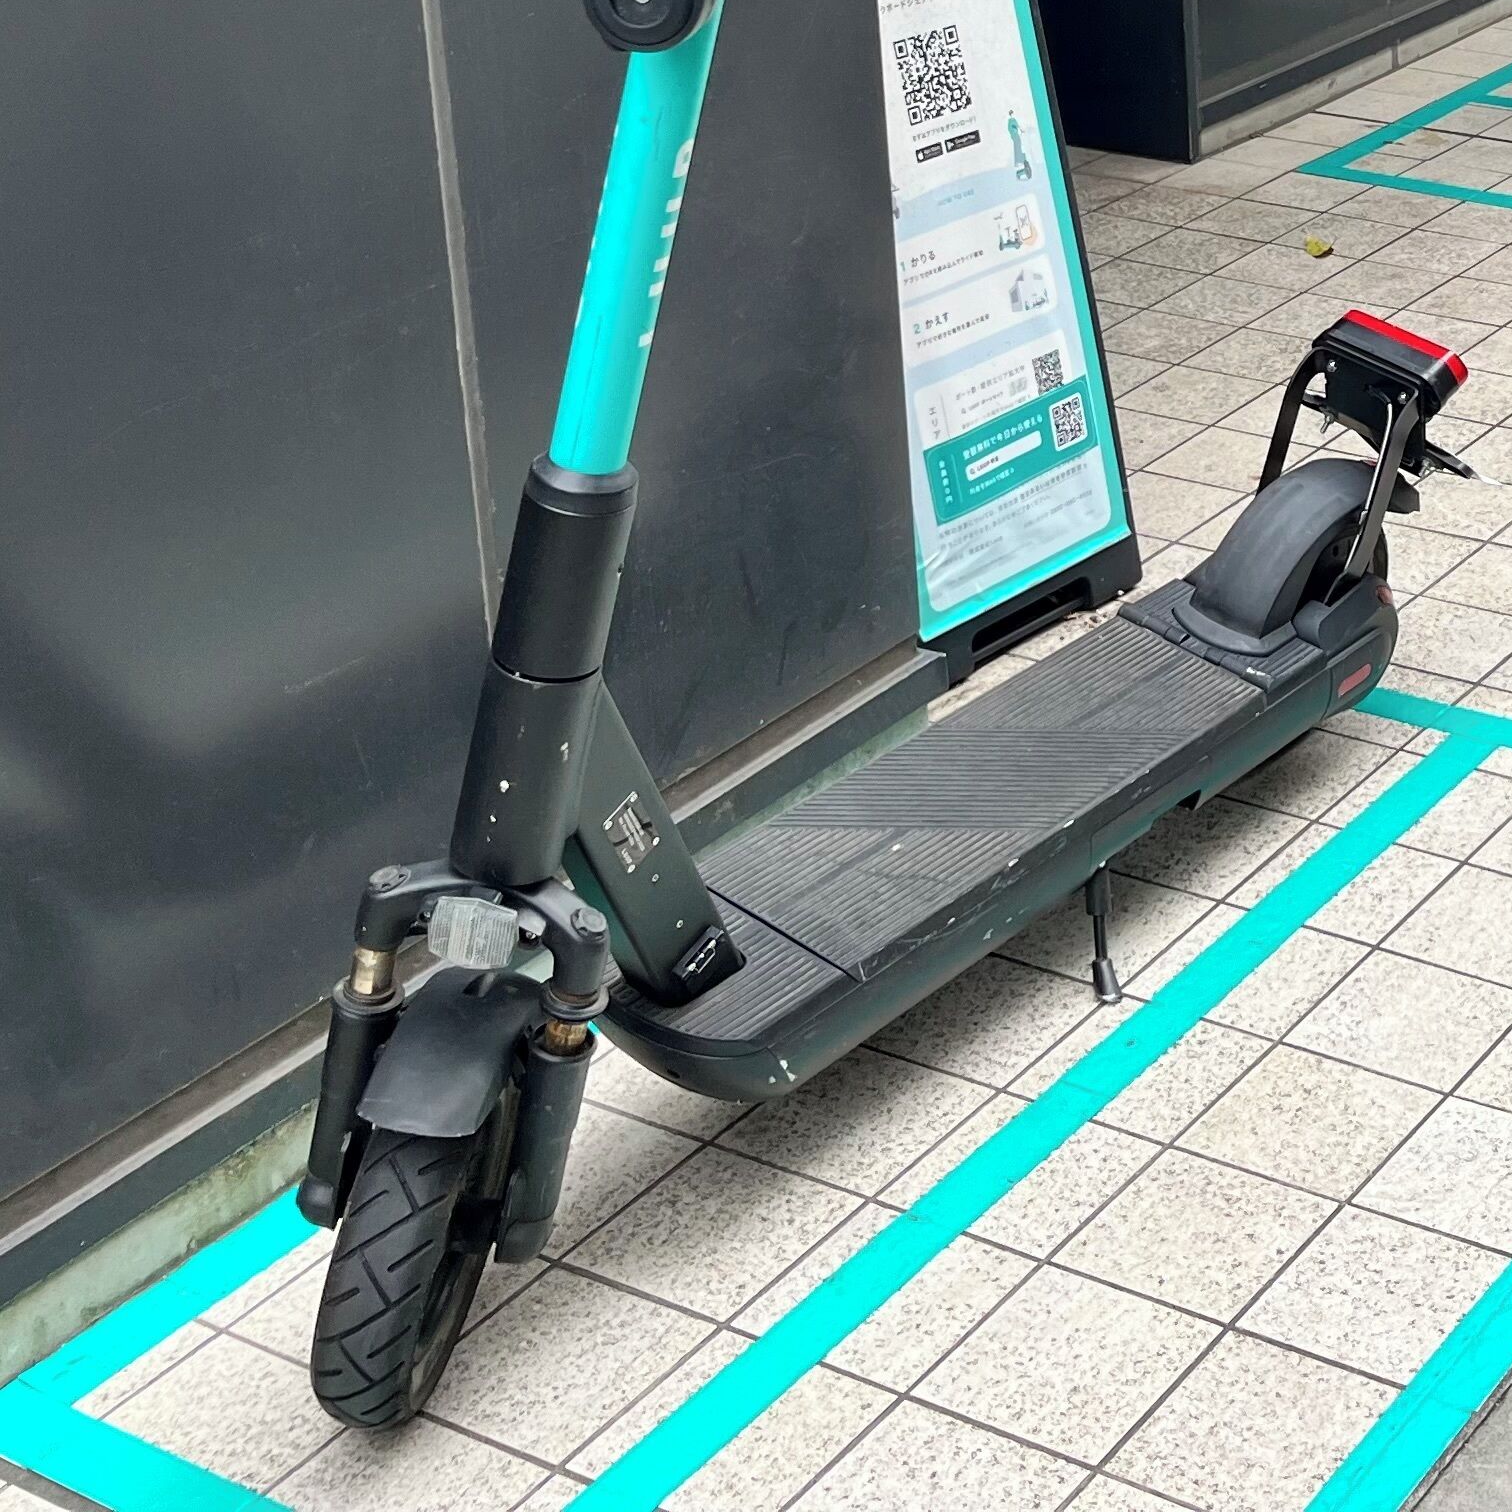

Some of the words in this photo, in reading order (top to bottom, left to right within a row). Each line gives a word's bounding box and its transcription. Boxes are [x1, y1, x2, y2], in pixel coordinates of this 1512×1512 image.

[900, 261, 906, 272] 1
[911, 250, 937, 268] かりる
[913, 323, 921, 335] 2
[925, 311, 950, 330] かえす
